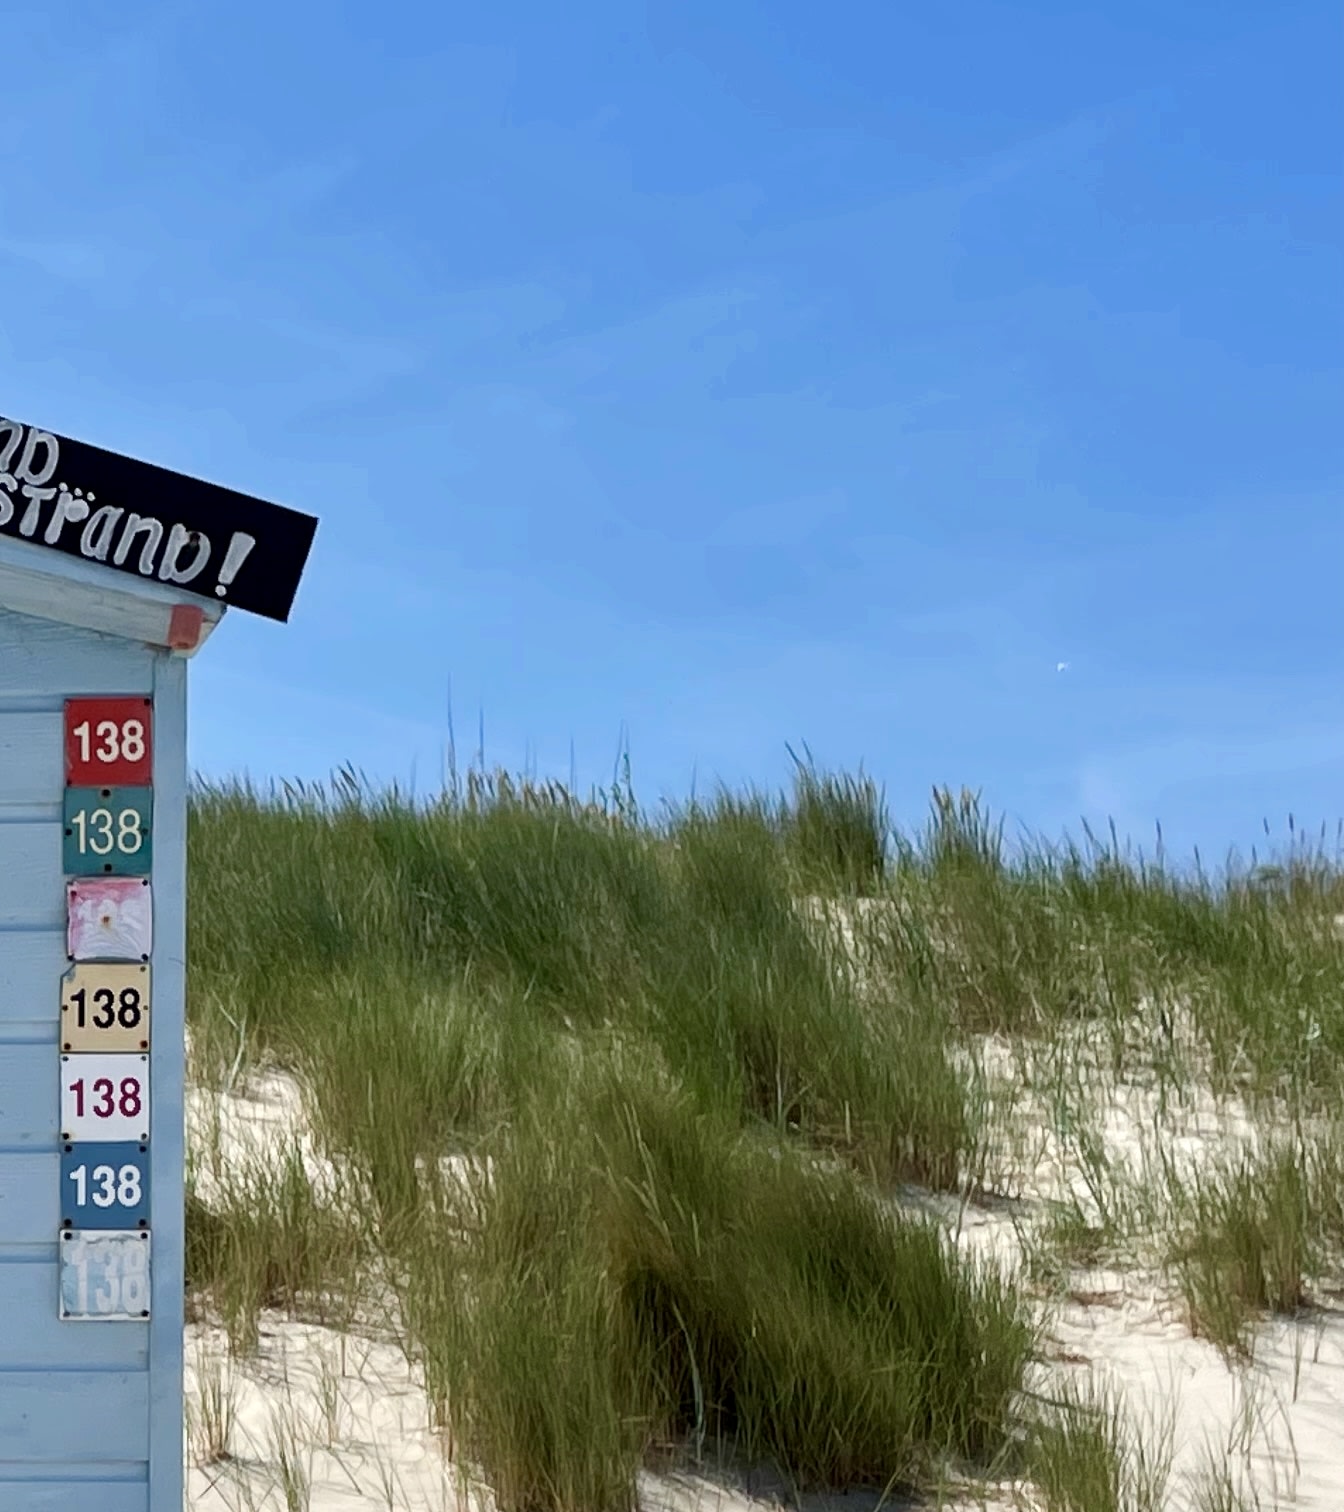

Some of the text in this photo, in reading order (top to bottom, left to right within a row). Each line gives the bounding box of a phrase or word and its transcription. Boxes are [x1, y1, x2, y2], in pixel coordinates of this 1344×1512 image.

[73, 719, 145, 762] 138
[71, 809, 143, 854] 138
[70, 988, 141, 1029] 138
[69, 1077, 141, 1118] 138
[69, 1165, 142, 1207] 138
